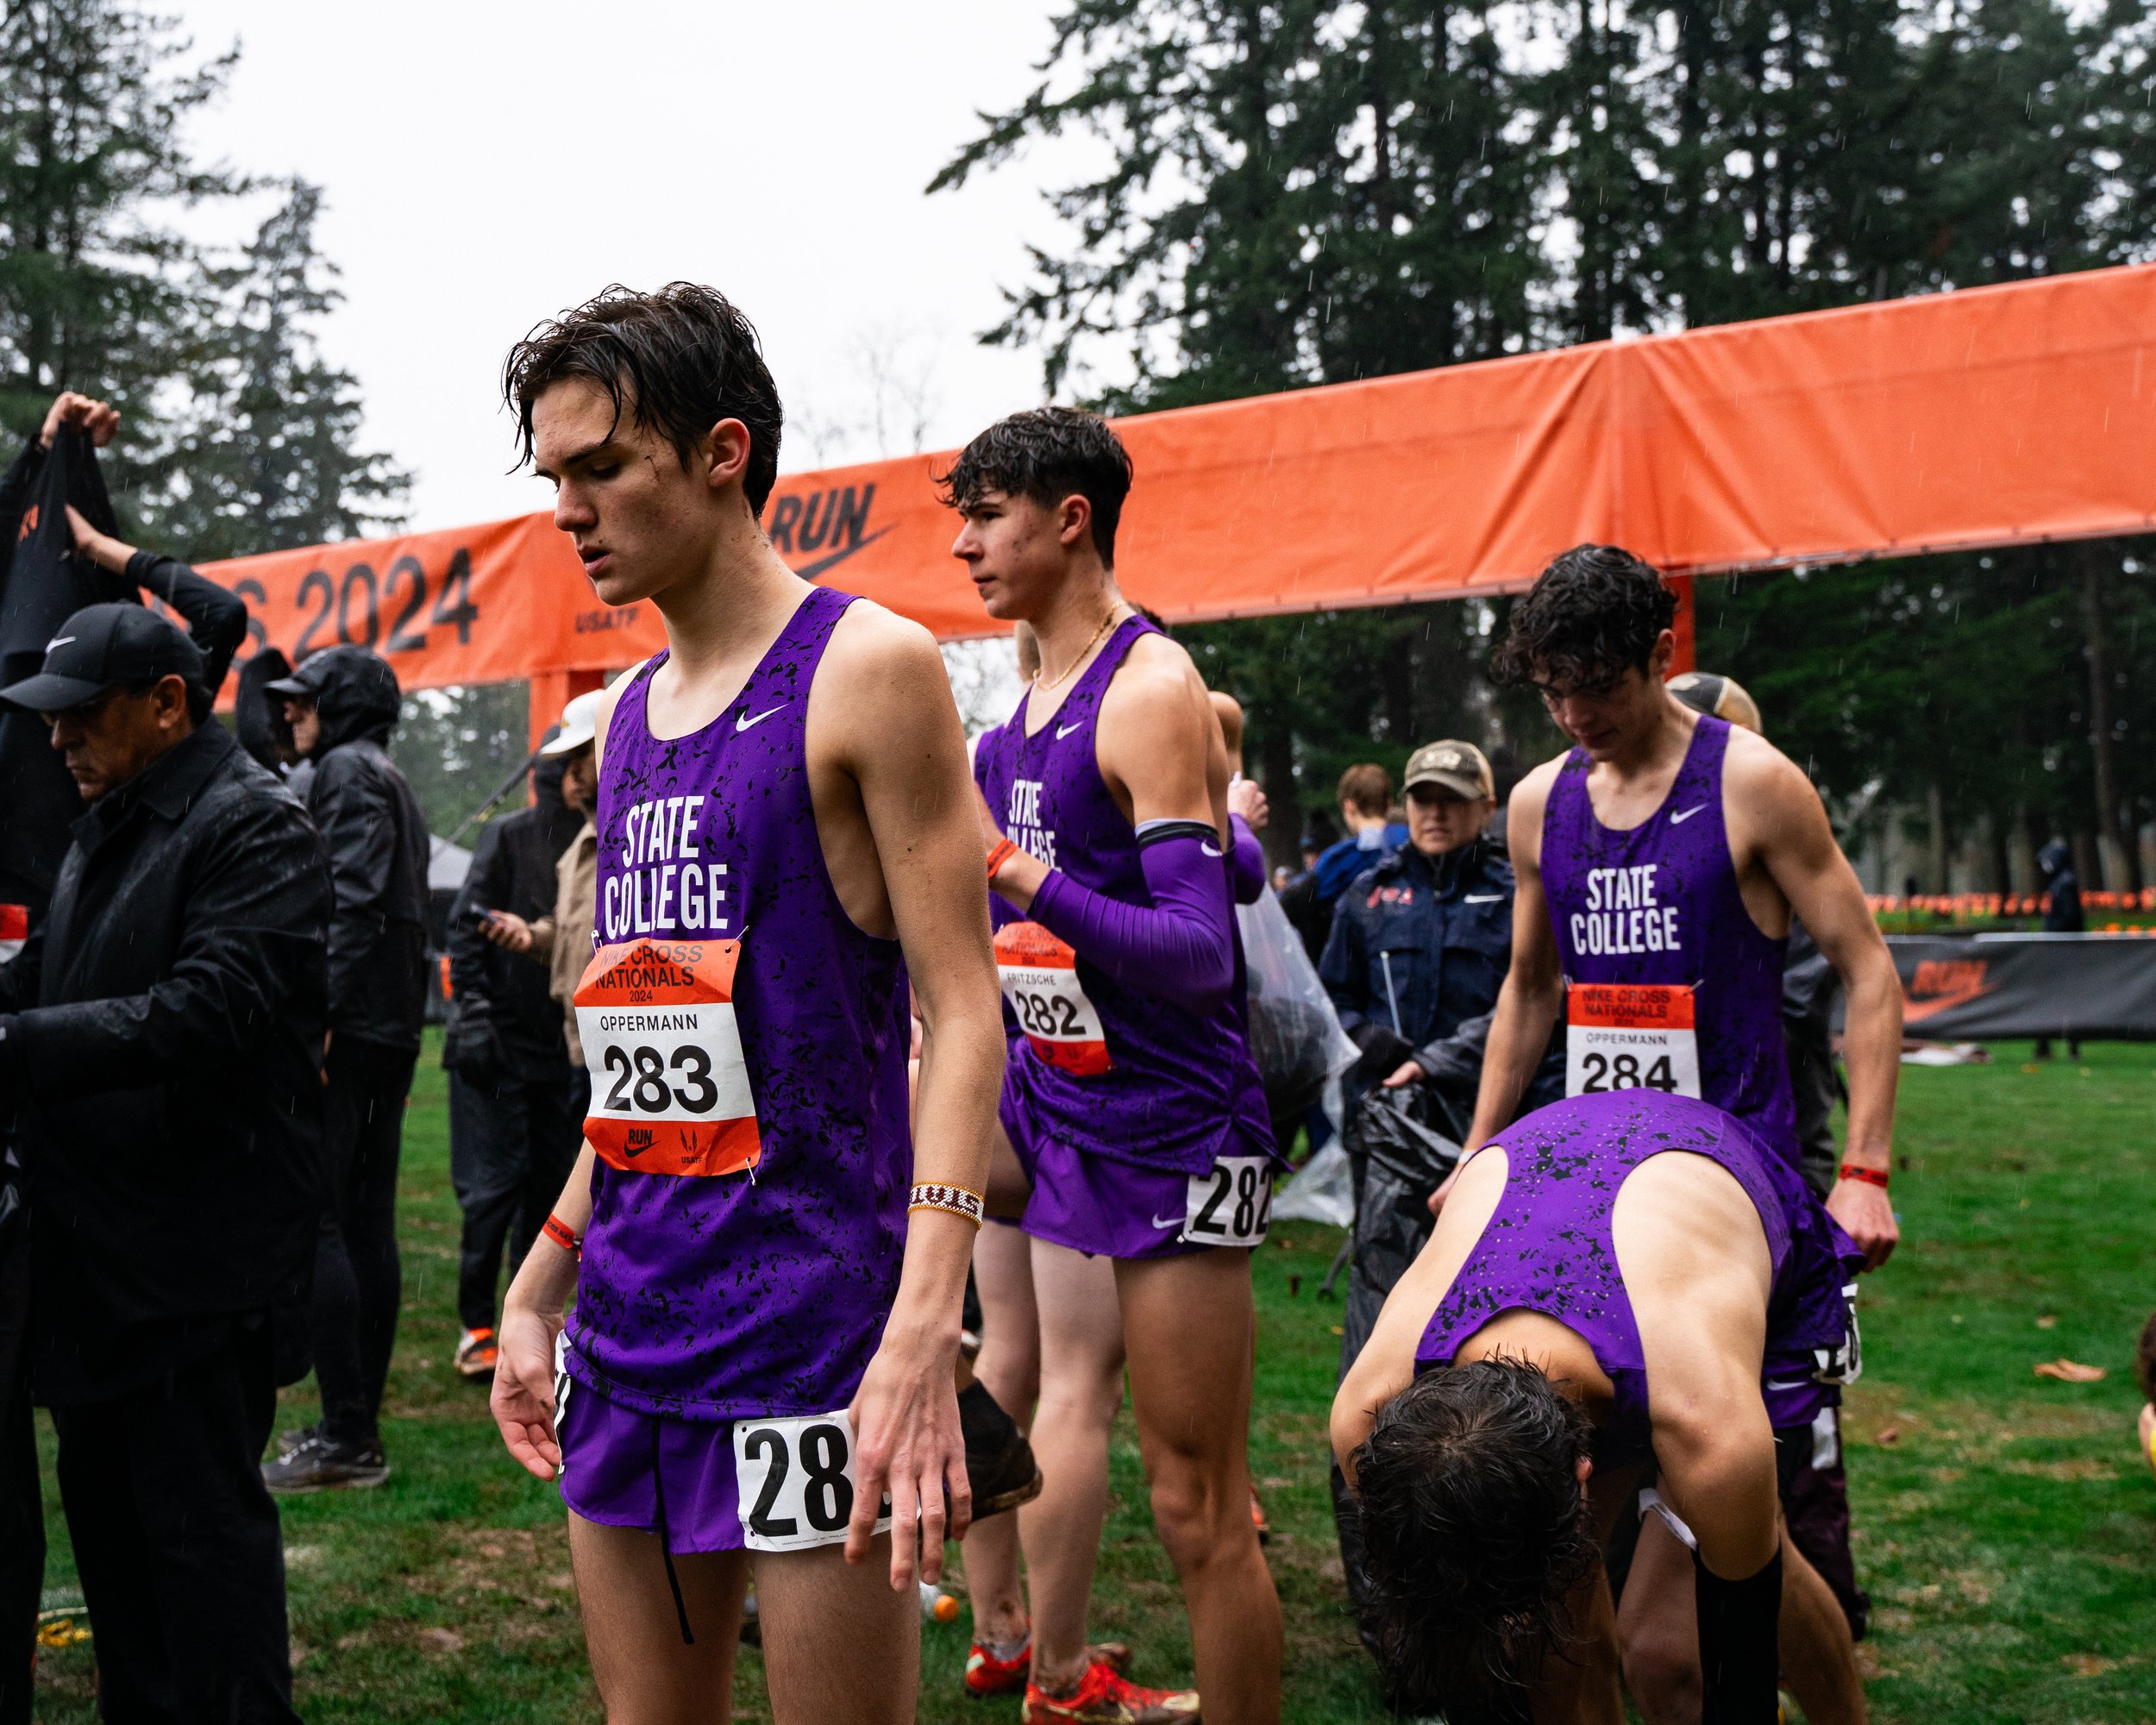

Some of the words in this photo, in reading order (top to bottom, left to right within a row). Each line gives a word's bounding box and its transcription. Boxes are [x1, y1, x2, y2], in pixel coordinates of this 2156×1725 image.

[772, 483, 875, 555] RUN
[293, 547, 478, 662] 2024
[1008, 779, 1043, 828] STAE
[622, 795, 705, 868] STATE
[605, 863, 728, 940] COLLEGE
[1585, 863, 1658, 912] STATE
[1570, 906, 1682, 956] COLLEGE
[595, 966, 695, 989] NATIONALS
[600, 949, 626, 969] NIKE
[630, 944, 704, 966] CROSS
[629, 989, 654, 1003] 2024
[1006, 972, 1057, 987] FRITZSCHE
[1583, 990, 1614, 1002] NIKE
[1617, 990, 1670, 1004] CROSS
[600, 1013, 699, 1032] OPPERMANN
[1014, 989, 1087, 1036] 282
[1584, 1004, 1667, 1019] NATIONALS
[1585, 1032, 1668, 1046] OPPERMANN
[603, 1044, 719, 1114] 283
[1582, 1051, 1678, 1095] 284
[628, 1128, 653, 1145] RUN
[681, 1156, 703, 1164] USATF
[1194, 1164, 1271, 1238] 282
